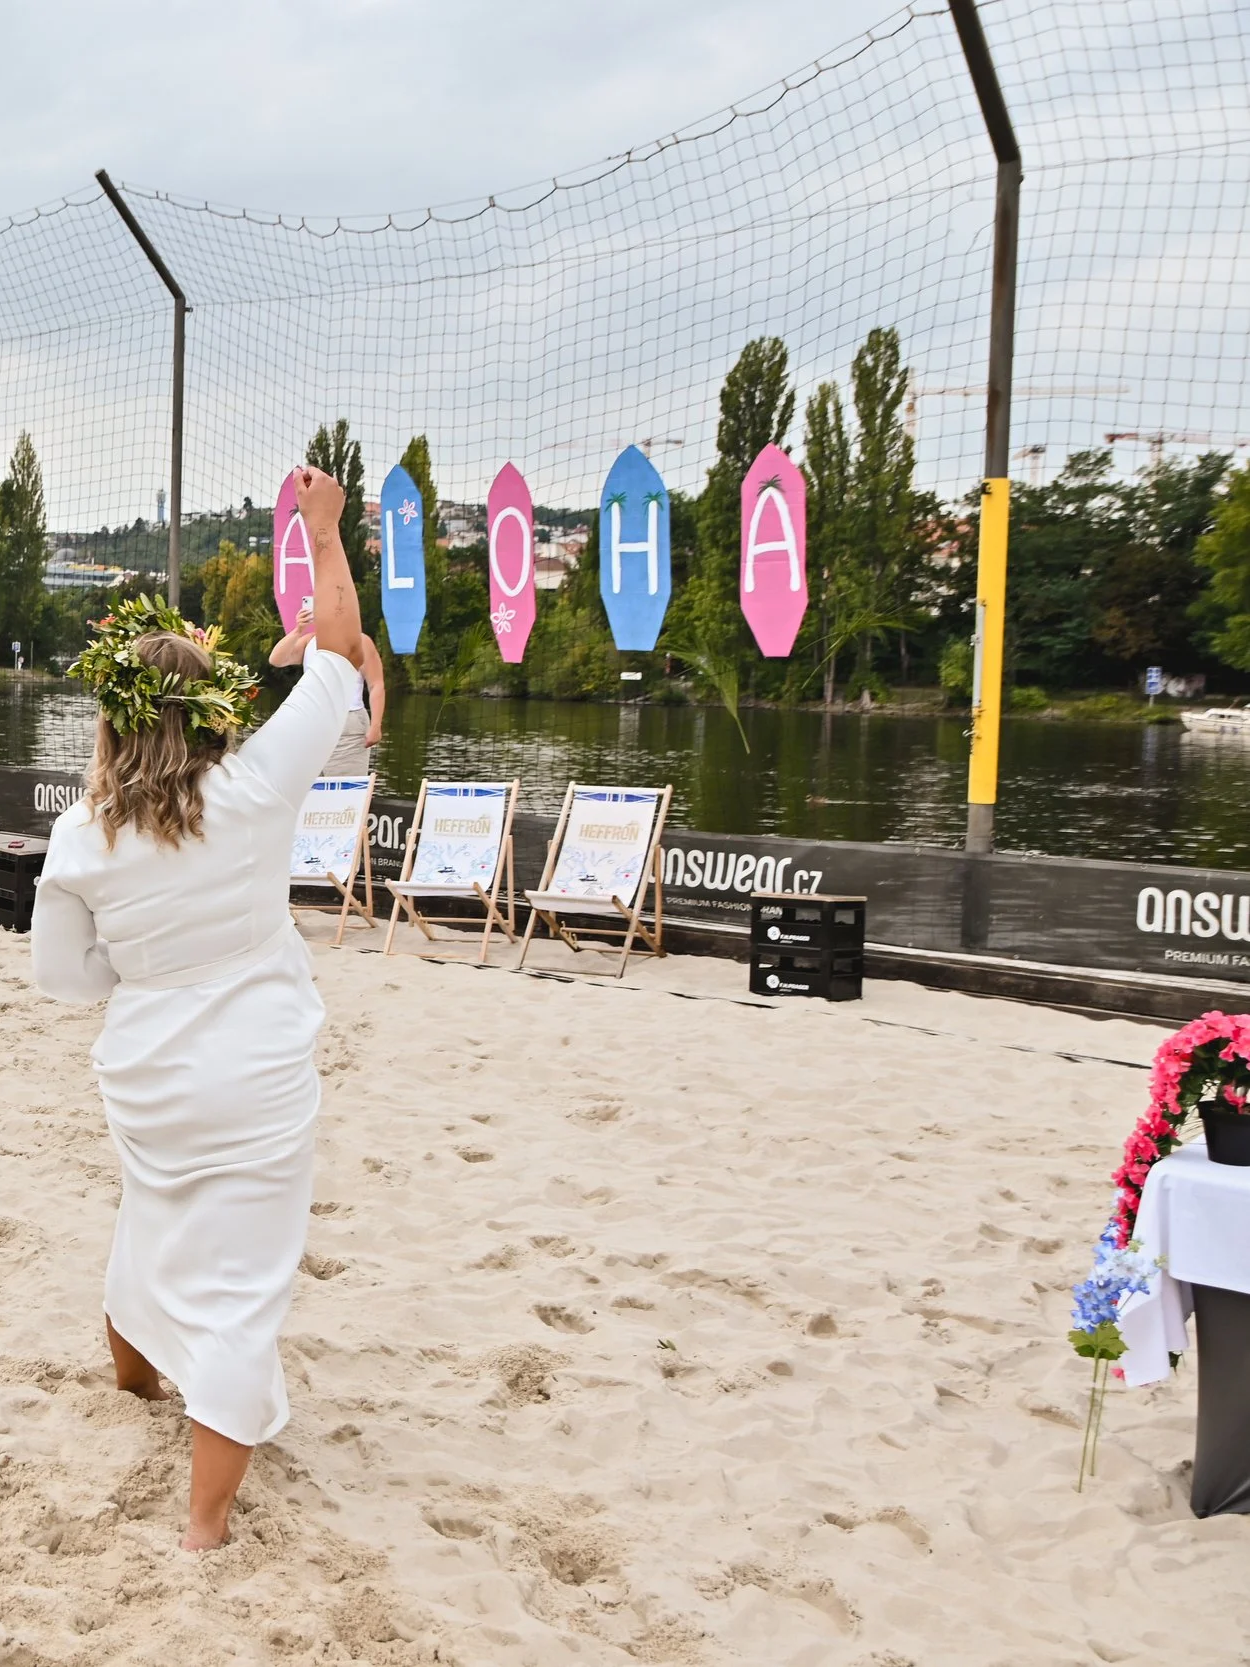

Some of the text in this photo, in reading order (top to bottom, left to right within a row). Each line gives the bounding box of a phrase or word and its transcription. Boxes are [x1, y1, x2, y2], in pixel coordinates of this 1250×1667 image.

[433, 817, 491, 834] HEFFRON
[579, 823, 639, 841] HEFFRON
[666, 897, 710, 907] PREMIUM
[1164, 949, 1229, 965] PREMIUM
